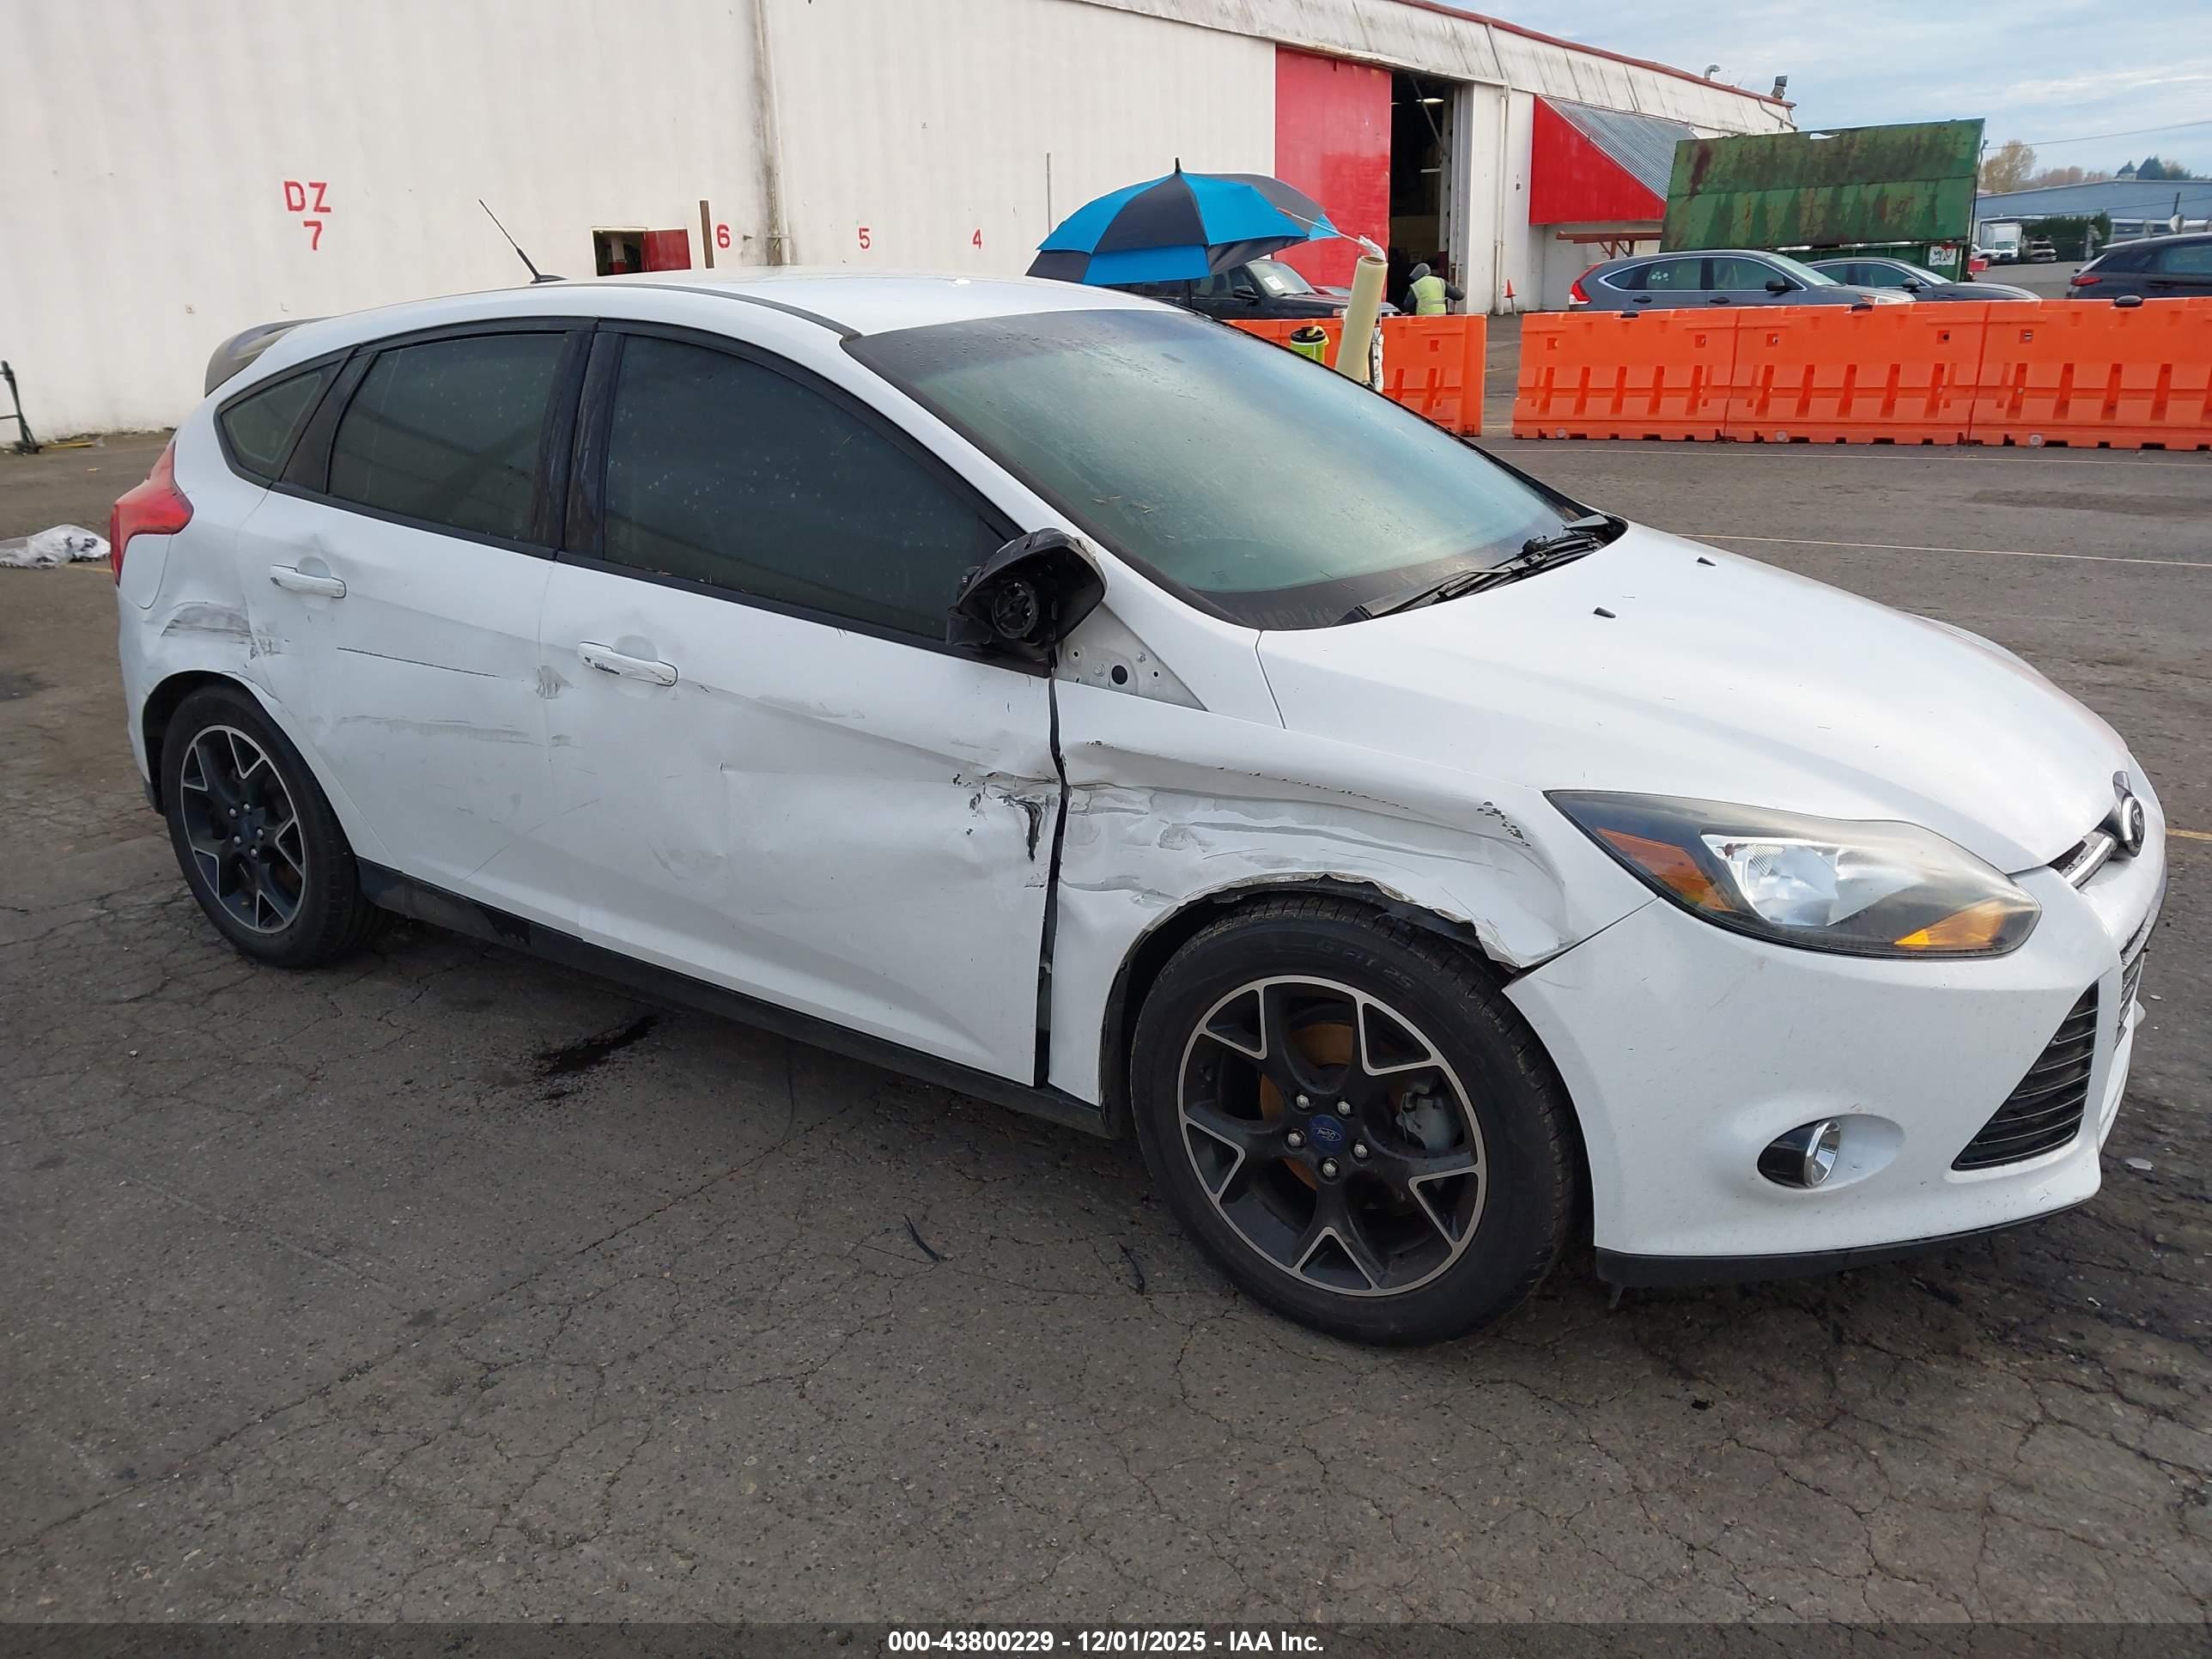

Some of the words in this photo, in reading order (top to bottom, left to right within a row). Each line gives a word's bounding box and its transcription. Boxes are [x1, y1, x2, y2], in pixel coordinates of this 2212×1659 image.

[283, 180, 331, 214] DZ
[303, 220, 323, 251] 7
[715, 223, 732, 249] 6
[859, 227, 871, 249] 5
[972, 229, 982, 249] 4
